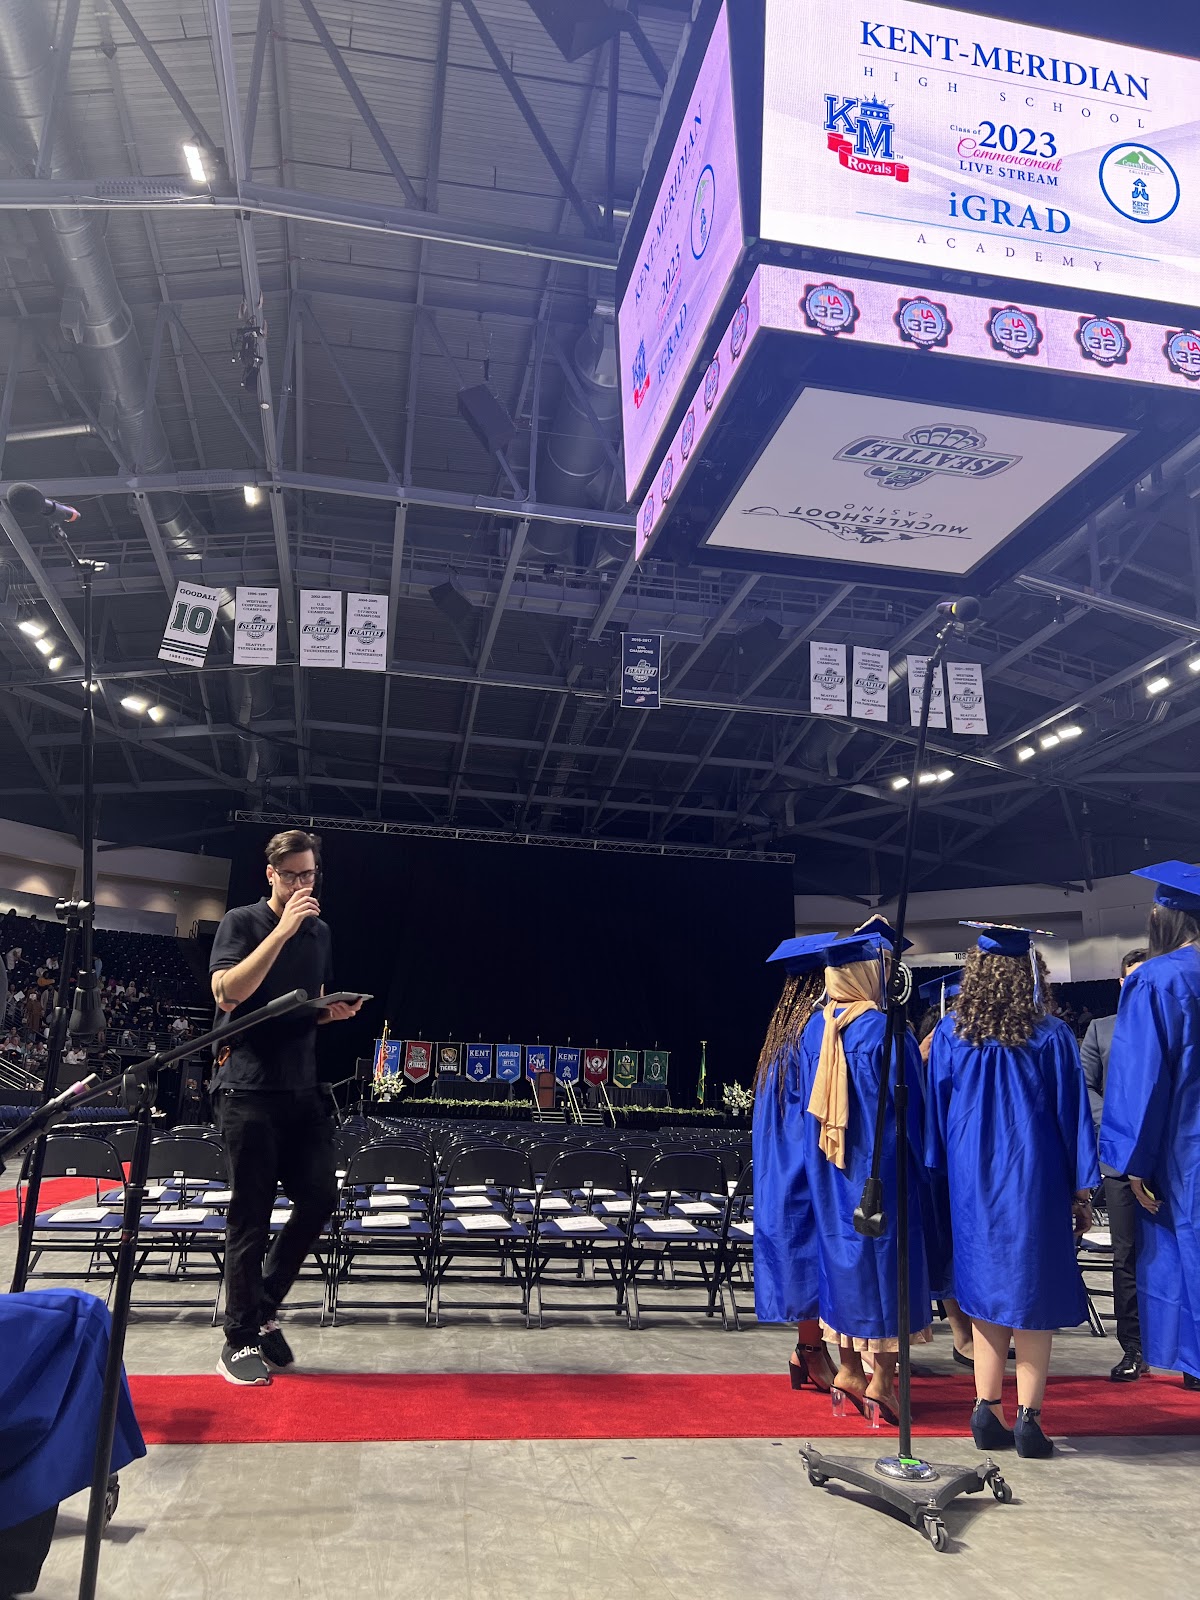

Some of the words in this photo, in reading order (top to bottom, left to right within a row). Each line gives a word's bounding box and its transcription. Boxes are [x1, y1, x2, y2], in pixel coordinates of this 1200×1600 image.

[860, 20, 1150, 102] KENT-MERIDIAN
[864, 66, 958, 94] HIGH
[999, 91, 1145, 129] SCHOOL
[824, 94, 895, 160] KM
[950, 124, 971, 134] Class
[979, 121, 1057, 158] 2023
[847, 155, 892, 174] Royals
[957, 136, 1063, 172] Commencement
[959, 160, 994, 175] LIVE
[998, 167, 1059, 186] STREAM
[949, 192, 1071, 234] iGRAD
[1132, 200, 1149, 208] KENT
[917, 233, 1102, 272] ACADEMY
[661, 243, 680, 309] 2023
[814, 304, 844, 321] 32
[908, 318, 937, 334] 32
[1000, 328, 1028, 343] 32
[657, 302, 687, 385] iGRAD
[1088, 336, 1116, 352] 32
[1175, 351, 1200, 364] 32
[862, 443, 995, 473] SEATTLE
[788, 505, 968, 535] MUCKLESHOOT
[844, 503, 933, 519] CASINO
[179, 588, 218, 602] GOODALL
[170, 600, 214, 635] 10
[860, 680, 882, 688] SEATTLE
[954, 952, 966, 960] 108
[558, 1053, 578, 1061] KENT
